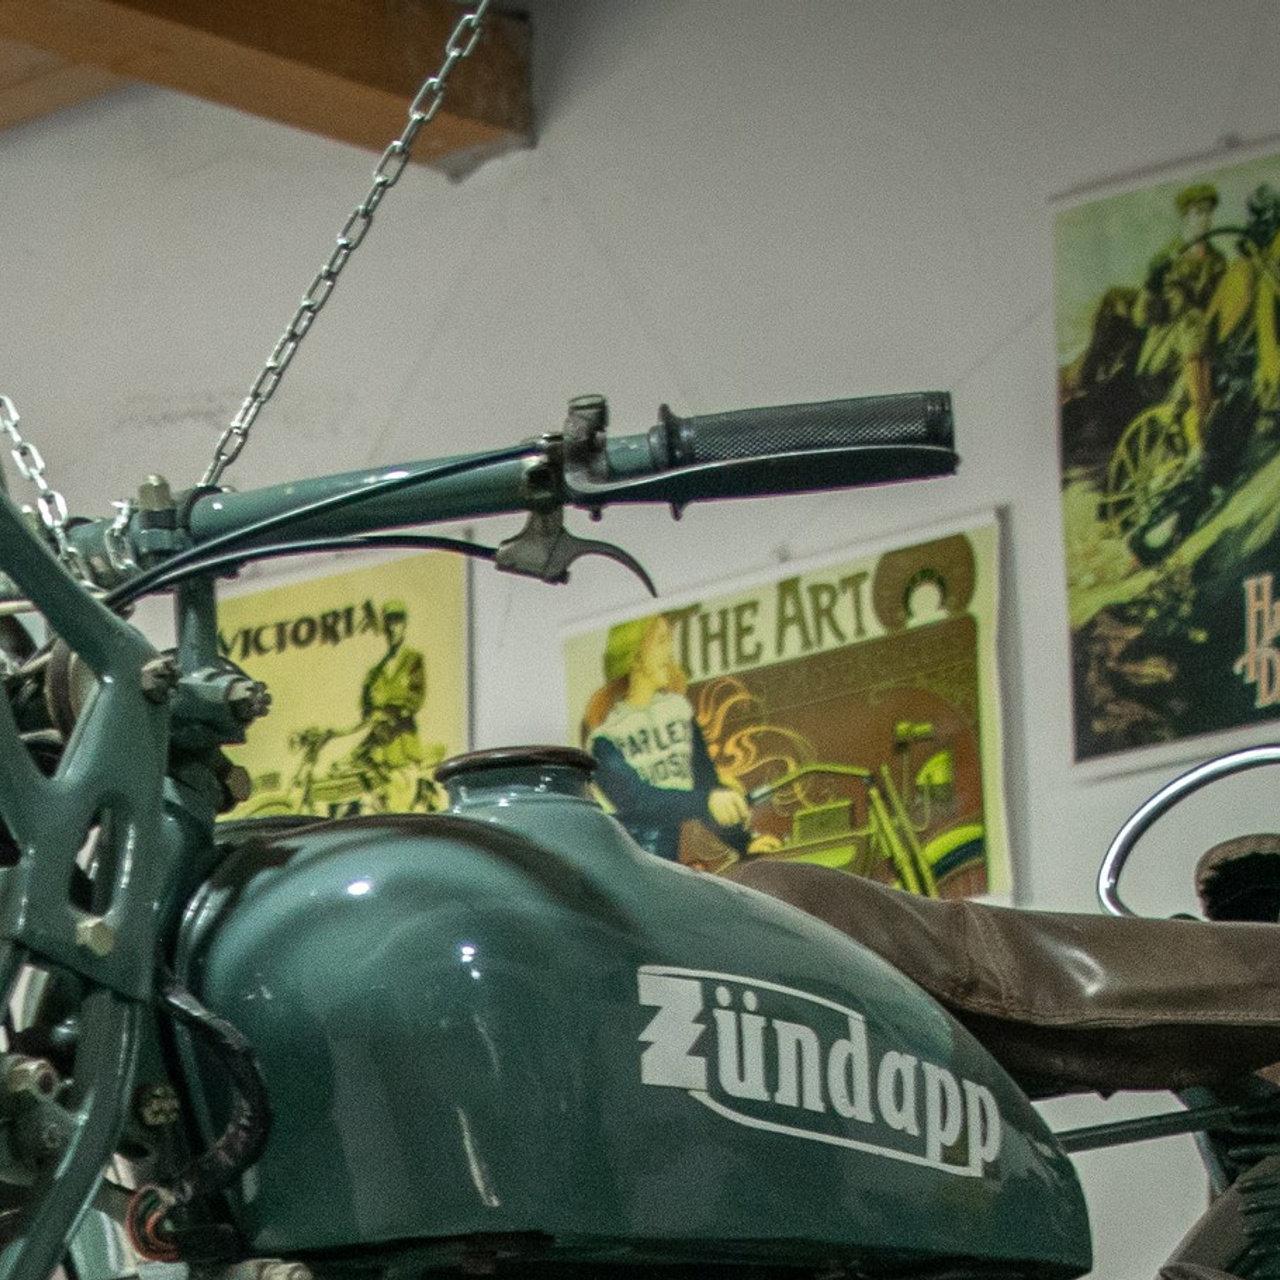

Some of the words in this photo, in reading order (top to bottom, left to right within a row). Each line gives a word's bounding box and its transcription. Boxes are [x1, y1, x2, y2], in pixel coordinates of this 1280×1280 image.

[218, 599, 383, 660] VICTORIA
[664, 603, 762, 677] THE
[775, 572, 869, 657] ART
[637, 968, 1002, 1178] Zündapp
